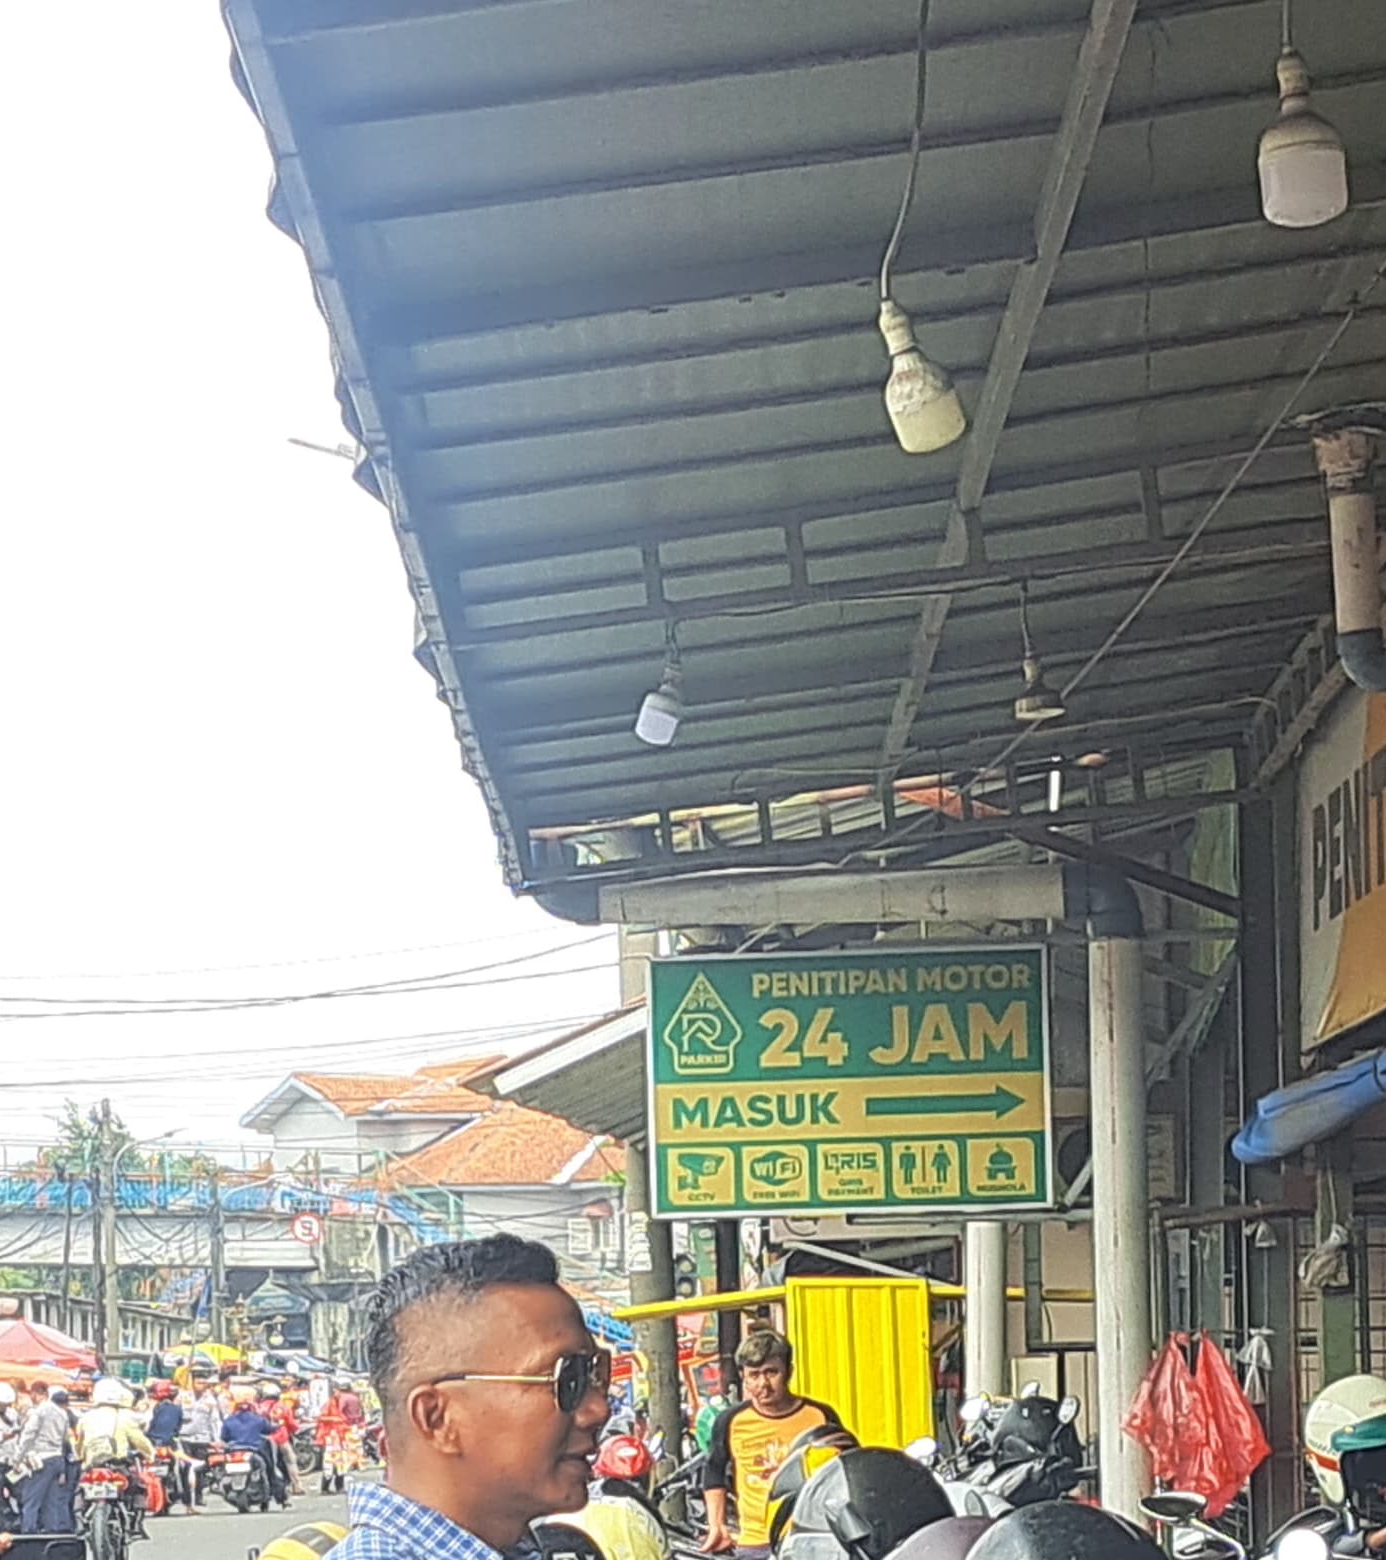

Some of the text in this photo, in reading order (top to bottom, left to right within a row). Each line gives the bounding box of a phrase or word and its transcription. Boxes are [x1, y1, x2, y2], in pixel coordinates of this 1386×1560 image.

[751, 964, 1031, 999] PENITIPAN MOTOR
[758, 1000, 1029, 1068] 24 JAM
[671, 1091, 840, 1130] MASUK
